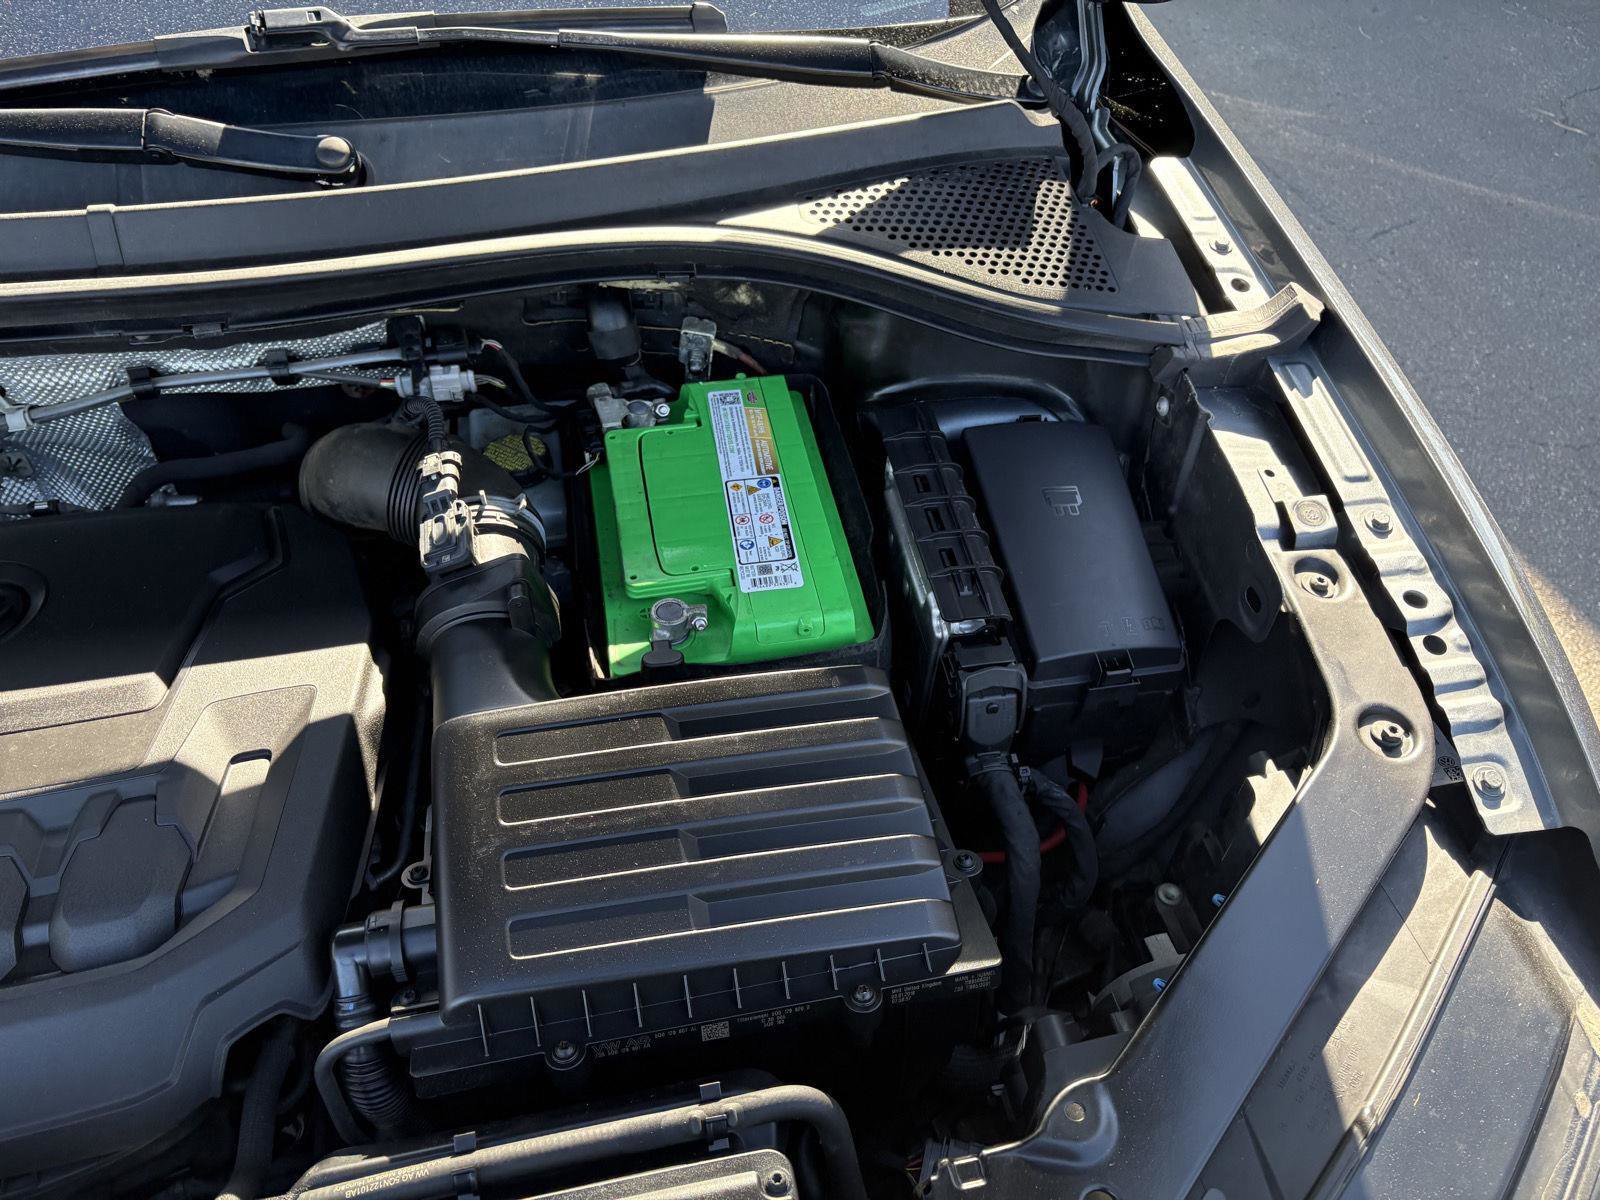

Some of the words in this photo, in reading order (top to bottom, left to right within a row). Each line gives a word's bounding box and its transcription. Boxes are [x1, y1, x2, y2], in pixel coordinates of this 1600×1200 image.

[592, 1040, 620, 1057] VW
[402, 1172, 415, 1182] AG
[416, 1168, 430, 1178] VW
